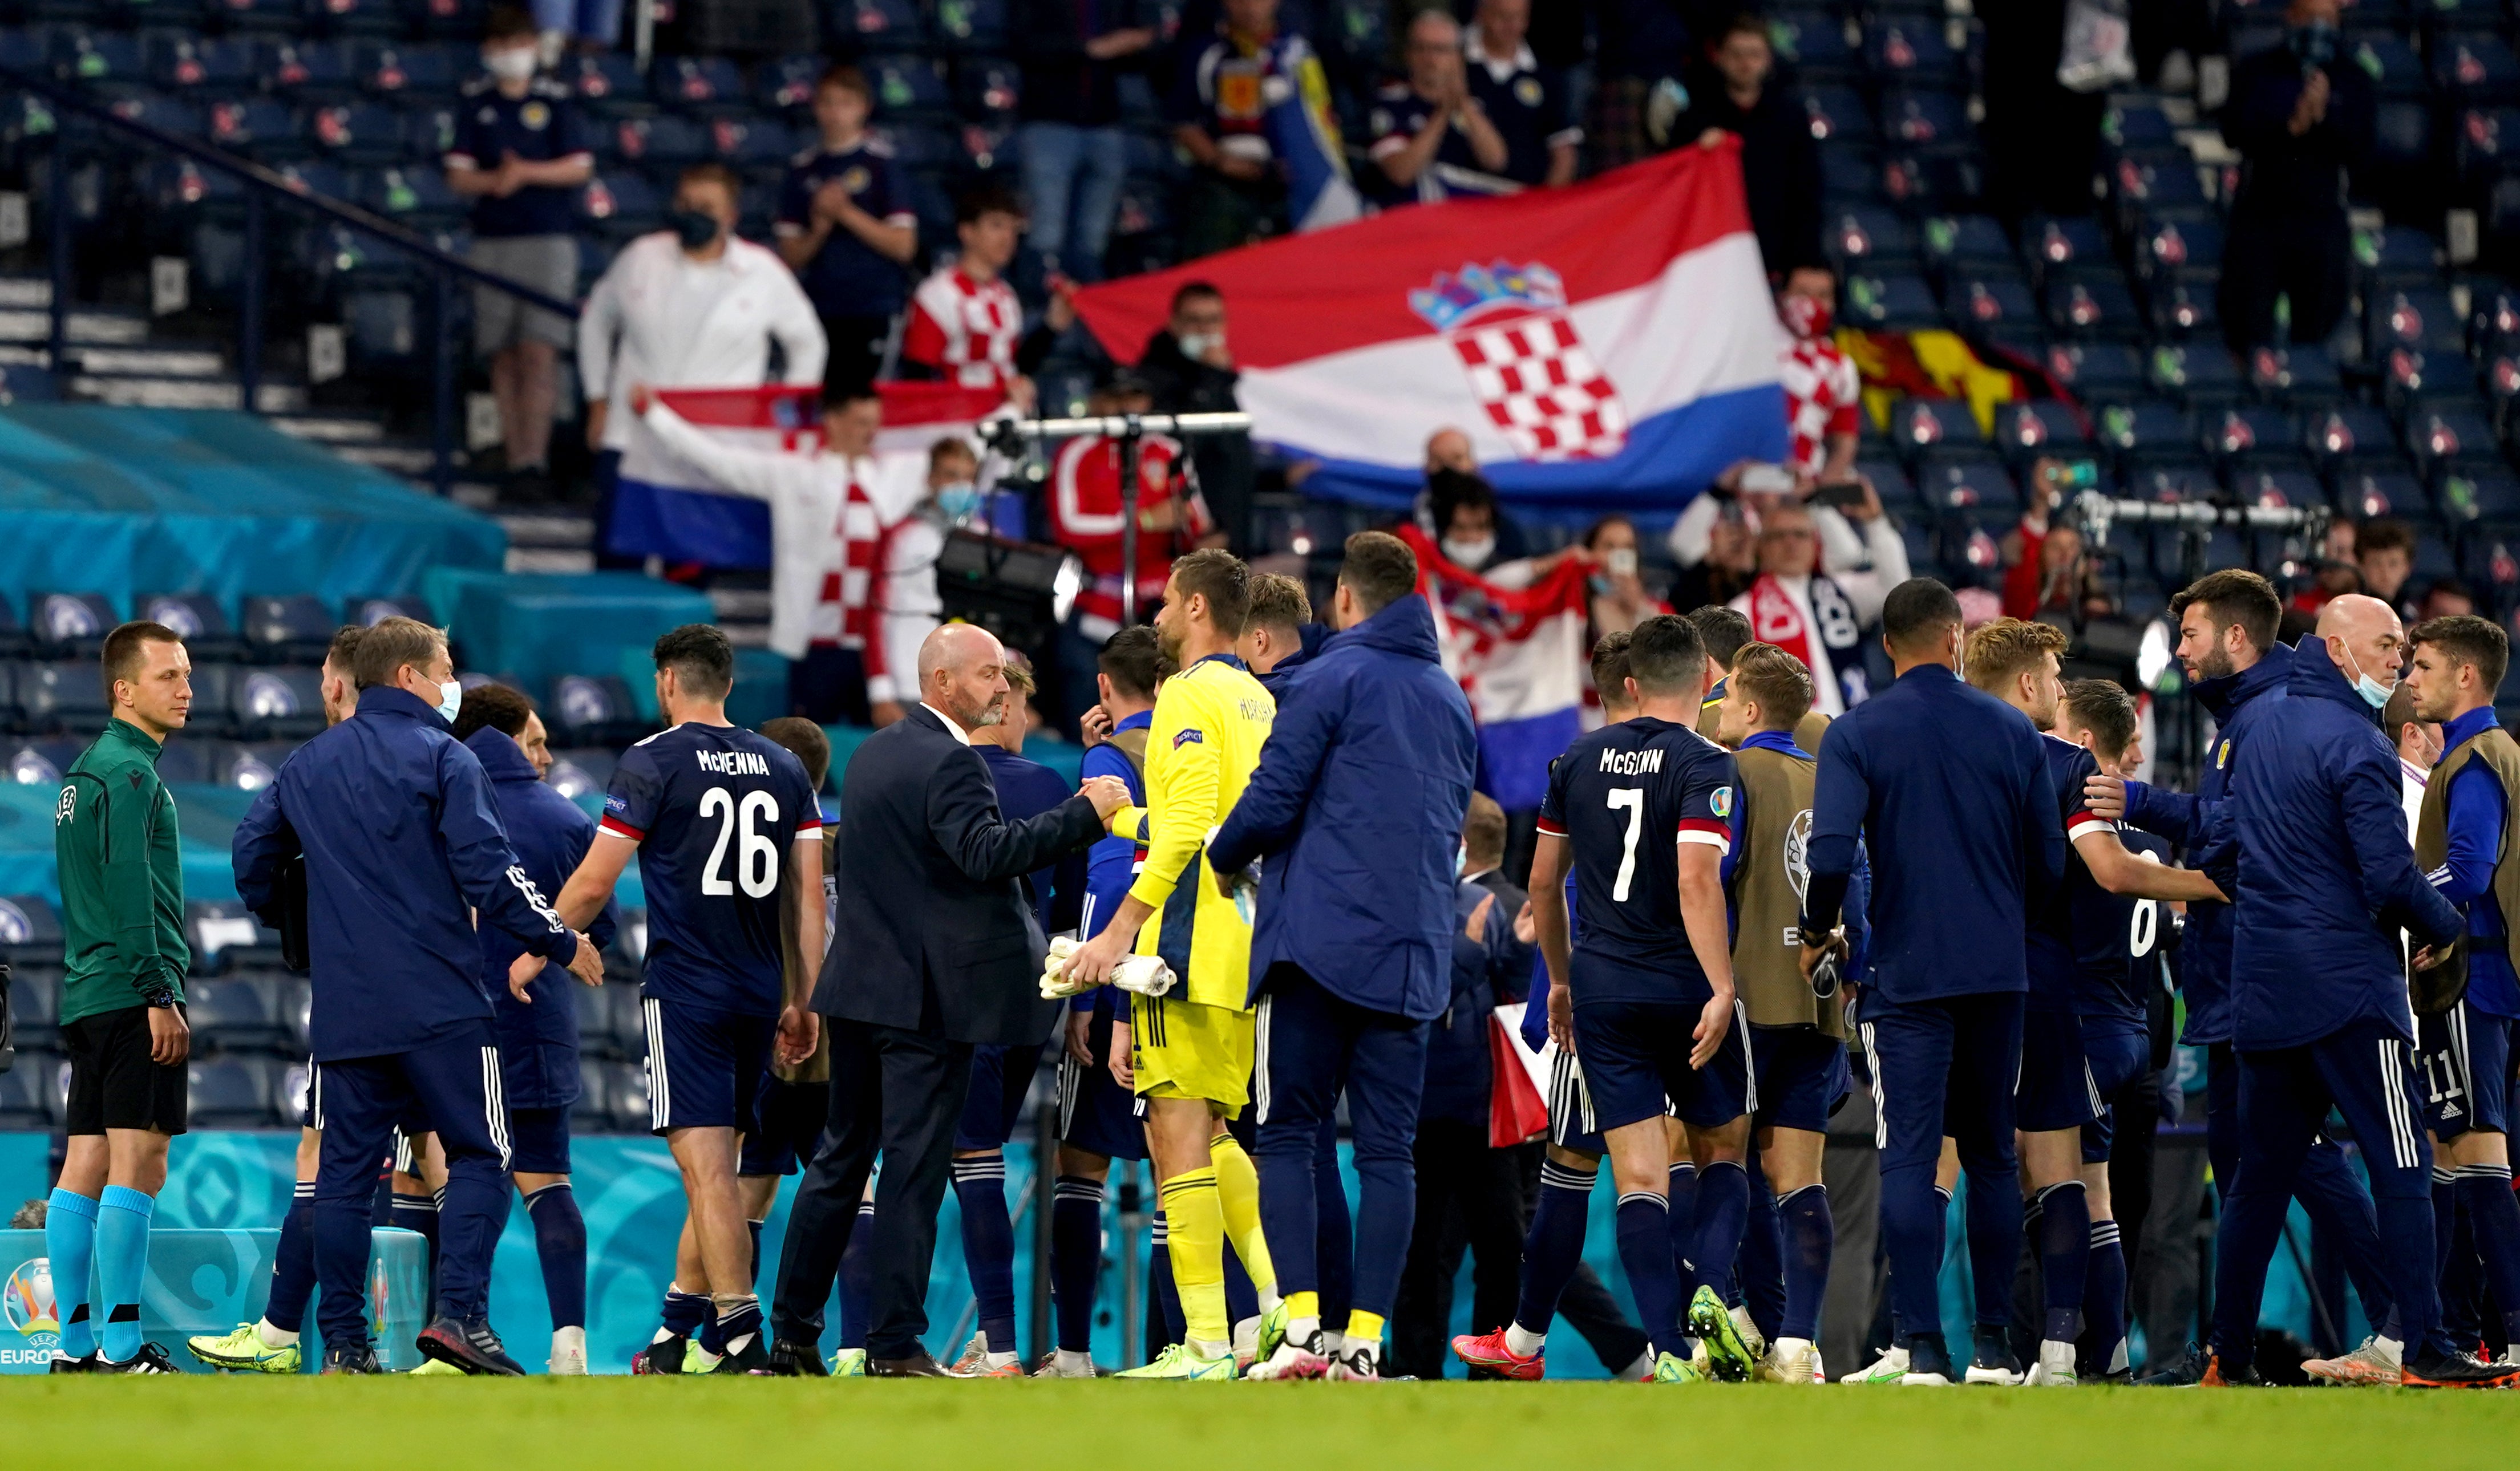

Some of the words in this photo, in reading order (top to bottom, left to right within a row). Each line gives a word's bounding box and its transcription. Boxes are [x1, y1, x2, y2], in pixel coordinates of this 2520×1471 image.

[696, 750, 770, 775] McKENNA
[1599, 748, 1664, 776] McGINN
[699, 787, 779, 898] 26
[1607, 788, 1643, 902] 7
[2424, 1049, 2464, 1103] 11
[30, 1335, 58, 1347] UEFA
[1, 1350, 51, 1364] EURO
